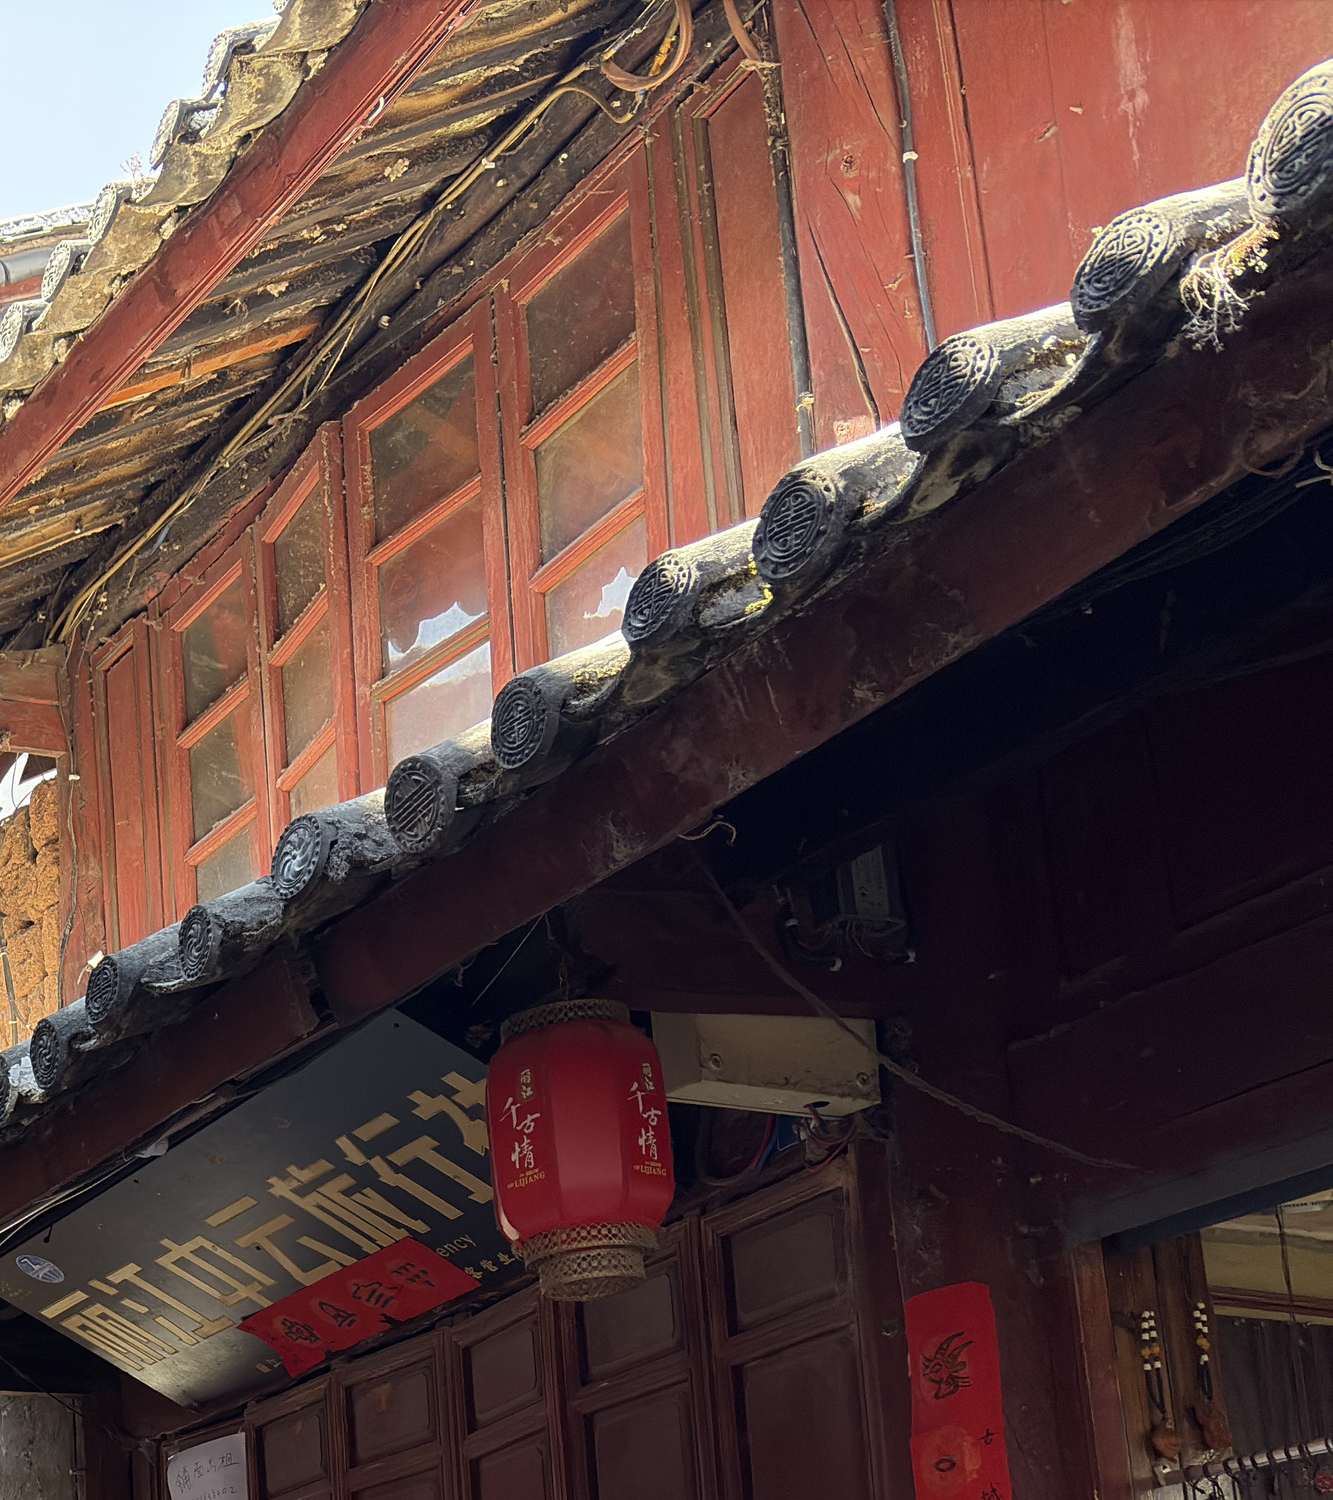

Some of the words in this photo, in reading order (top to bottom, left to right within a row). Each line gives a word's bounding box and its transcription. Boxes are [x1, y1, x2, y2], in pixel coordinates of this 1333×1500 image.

[499, 1096, 542, 1170] 千古情
[628, 1081, 662, 1161] 千古情
[514, 1171, 546, 1189] LIJIANG
[640, 1164, 667, 1177] LIJIANG
